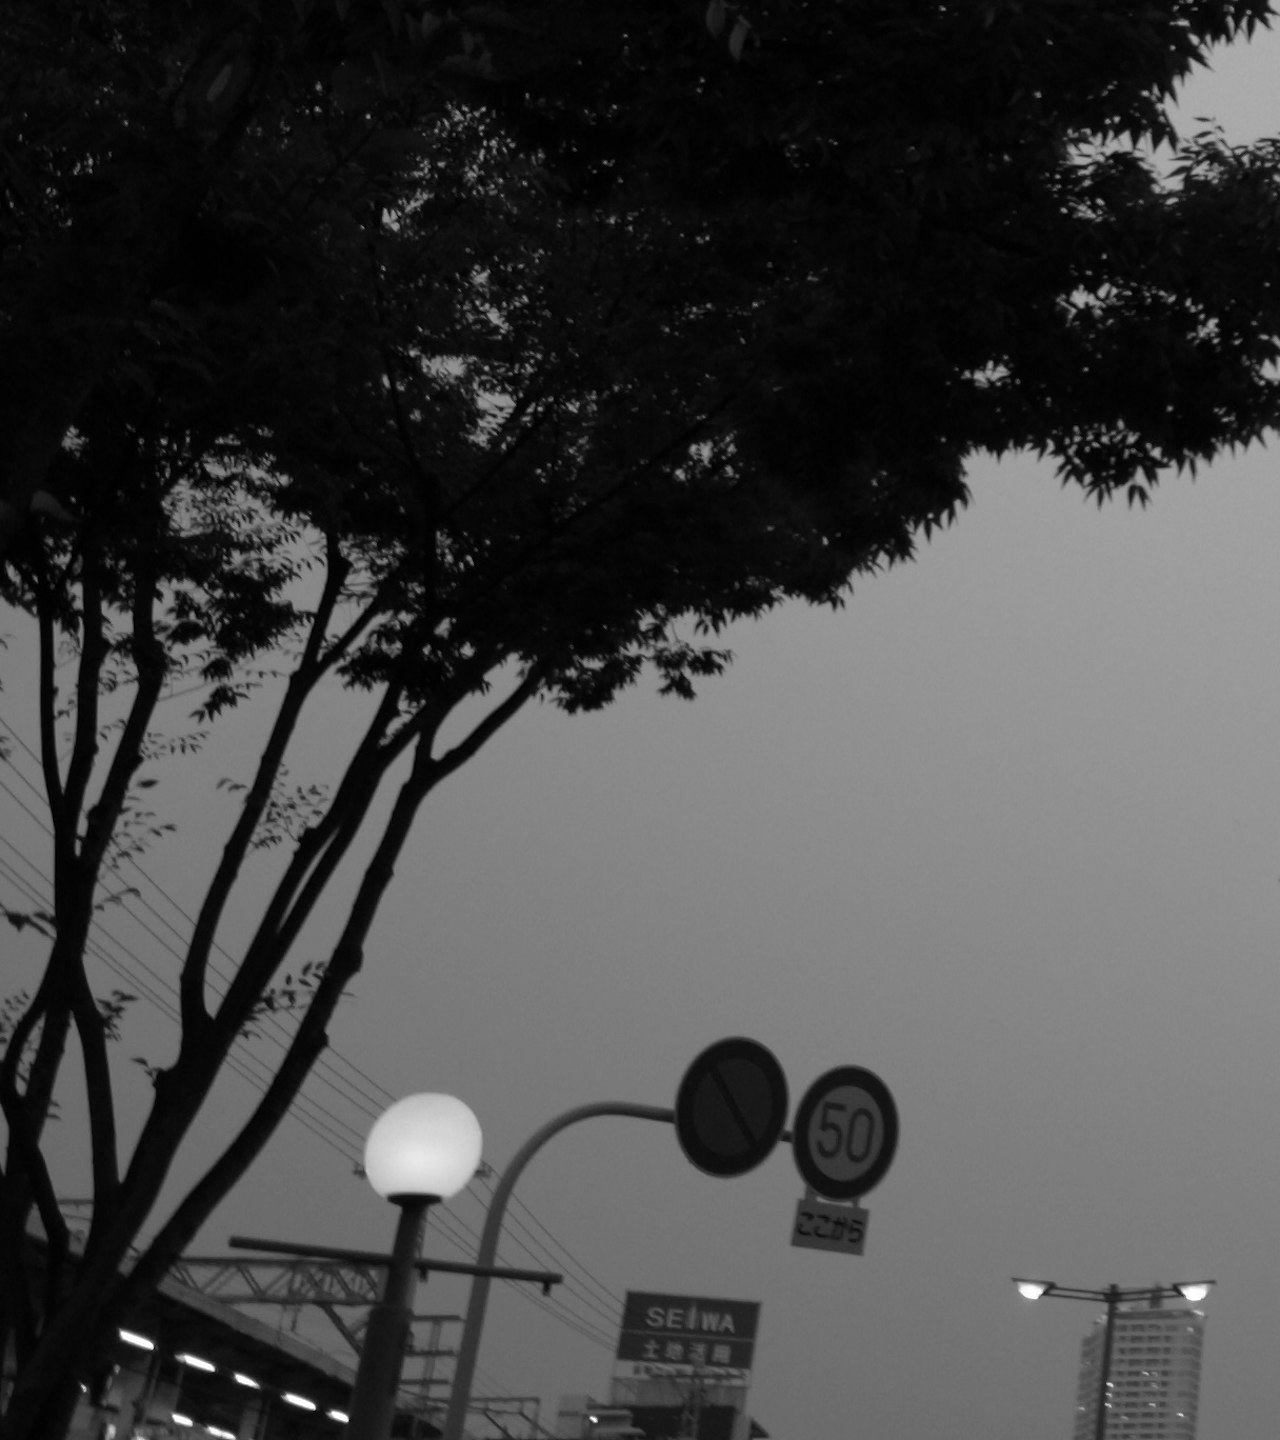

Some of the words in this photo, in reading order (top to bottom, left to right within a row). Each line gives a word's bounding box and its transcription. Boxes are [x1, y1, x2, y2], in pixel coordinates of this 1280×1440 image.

[816, 1101, 876, 1164] 50
[796, 1210, 865, 1245] ここから
[645, 1303, 737, 1335] SEIWA
